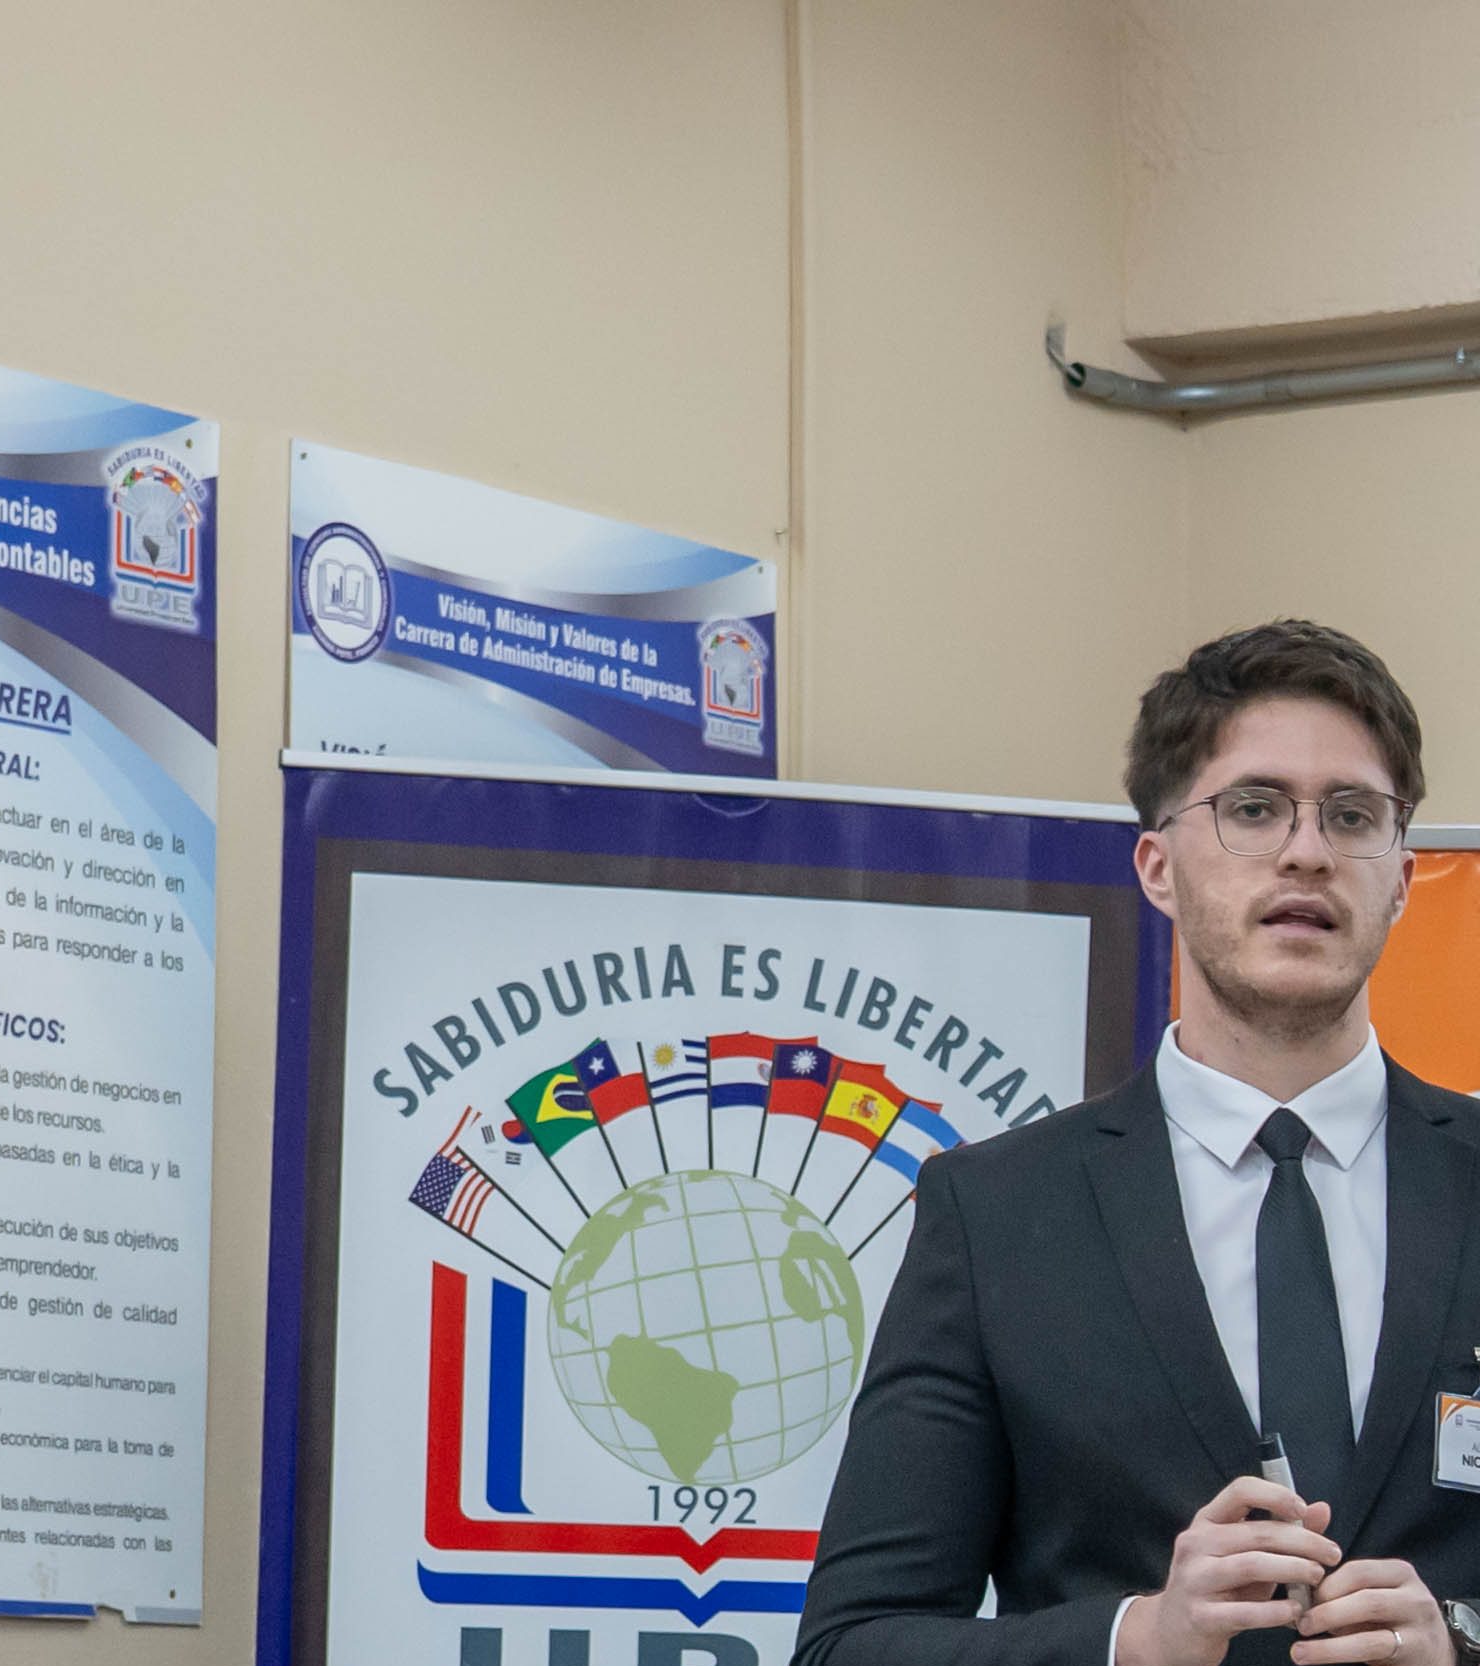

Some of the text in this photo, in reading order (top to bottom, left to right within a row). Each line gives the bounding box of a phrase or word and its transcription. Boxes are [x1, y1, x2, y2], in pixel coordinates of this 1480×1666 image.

[395, 616, 695, 705] Carrera de Administración de Empresas.
[439, 594, 657, 666] Visión, Misión y Valores de la
[50, 818, 69, 834] en
[78, 820, 92, 838] el
[101, 824, 135, 846] área
[143, 831, 163, 851] de
[172, 833, 185, 854] la
[372, 943, 696, 1118] SABIDURIA
[721, 944, 781, 1000] ES
[647, 1486, 757, 1525] 1992
